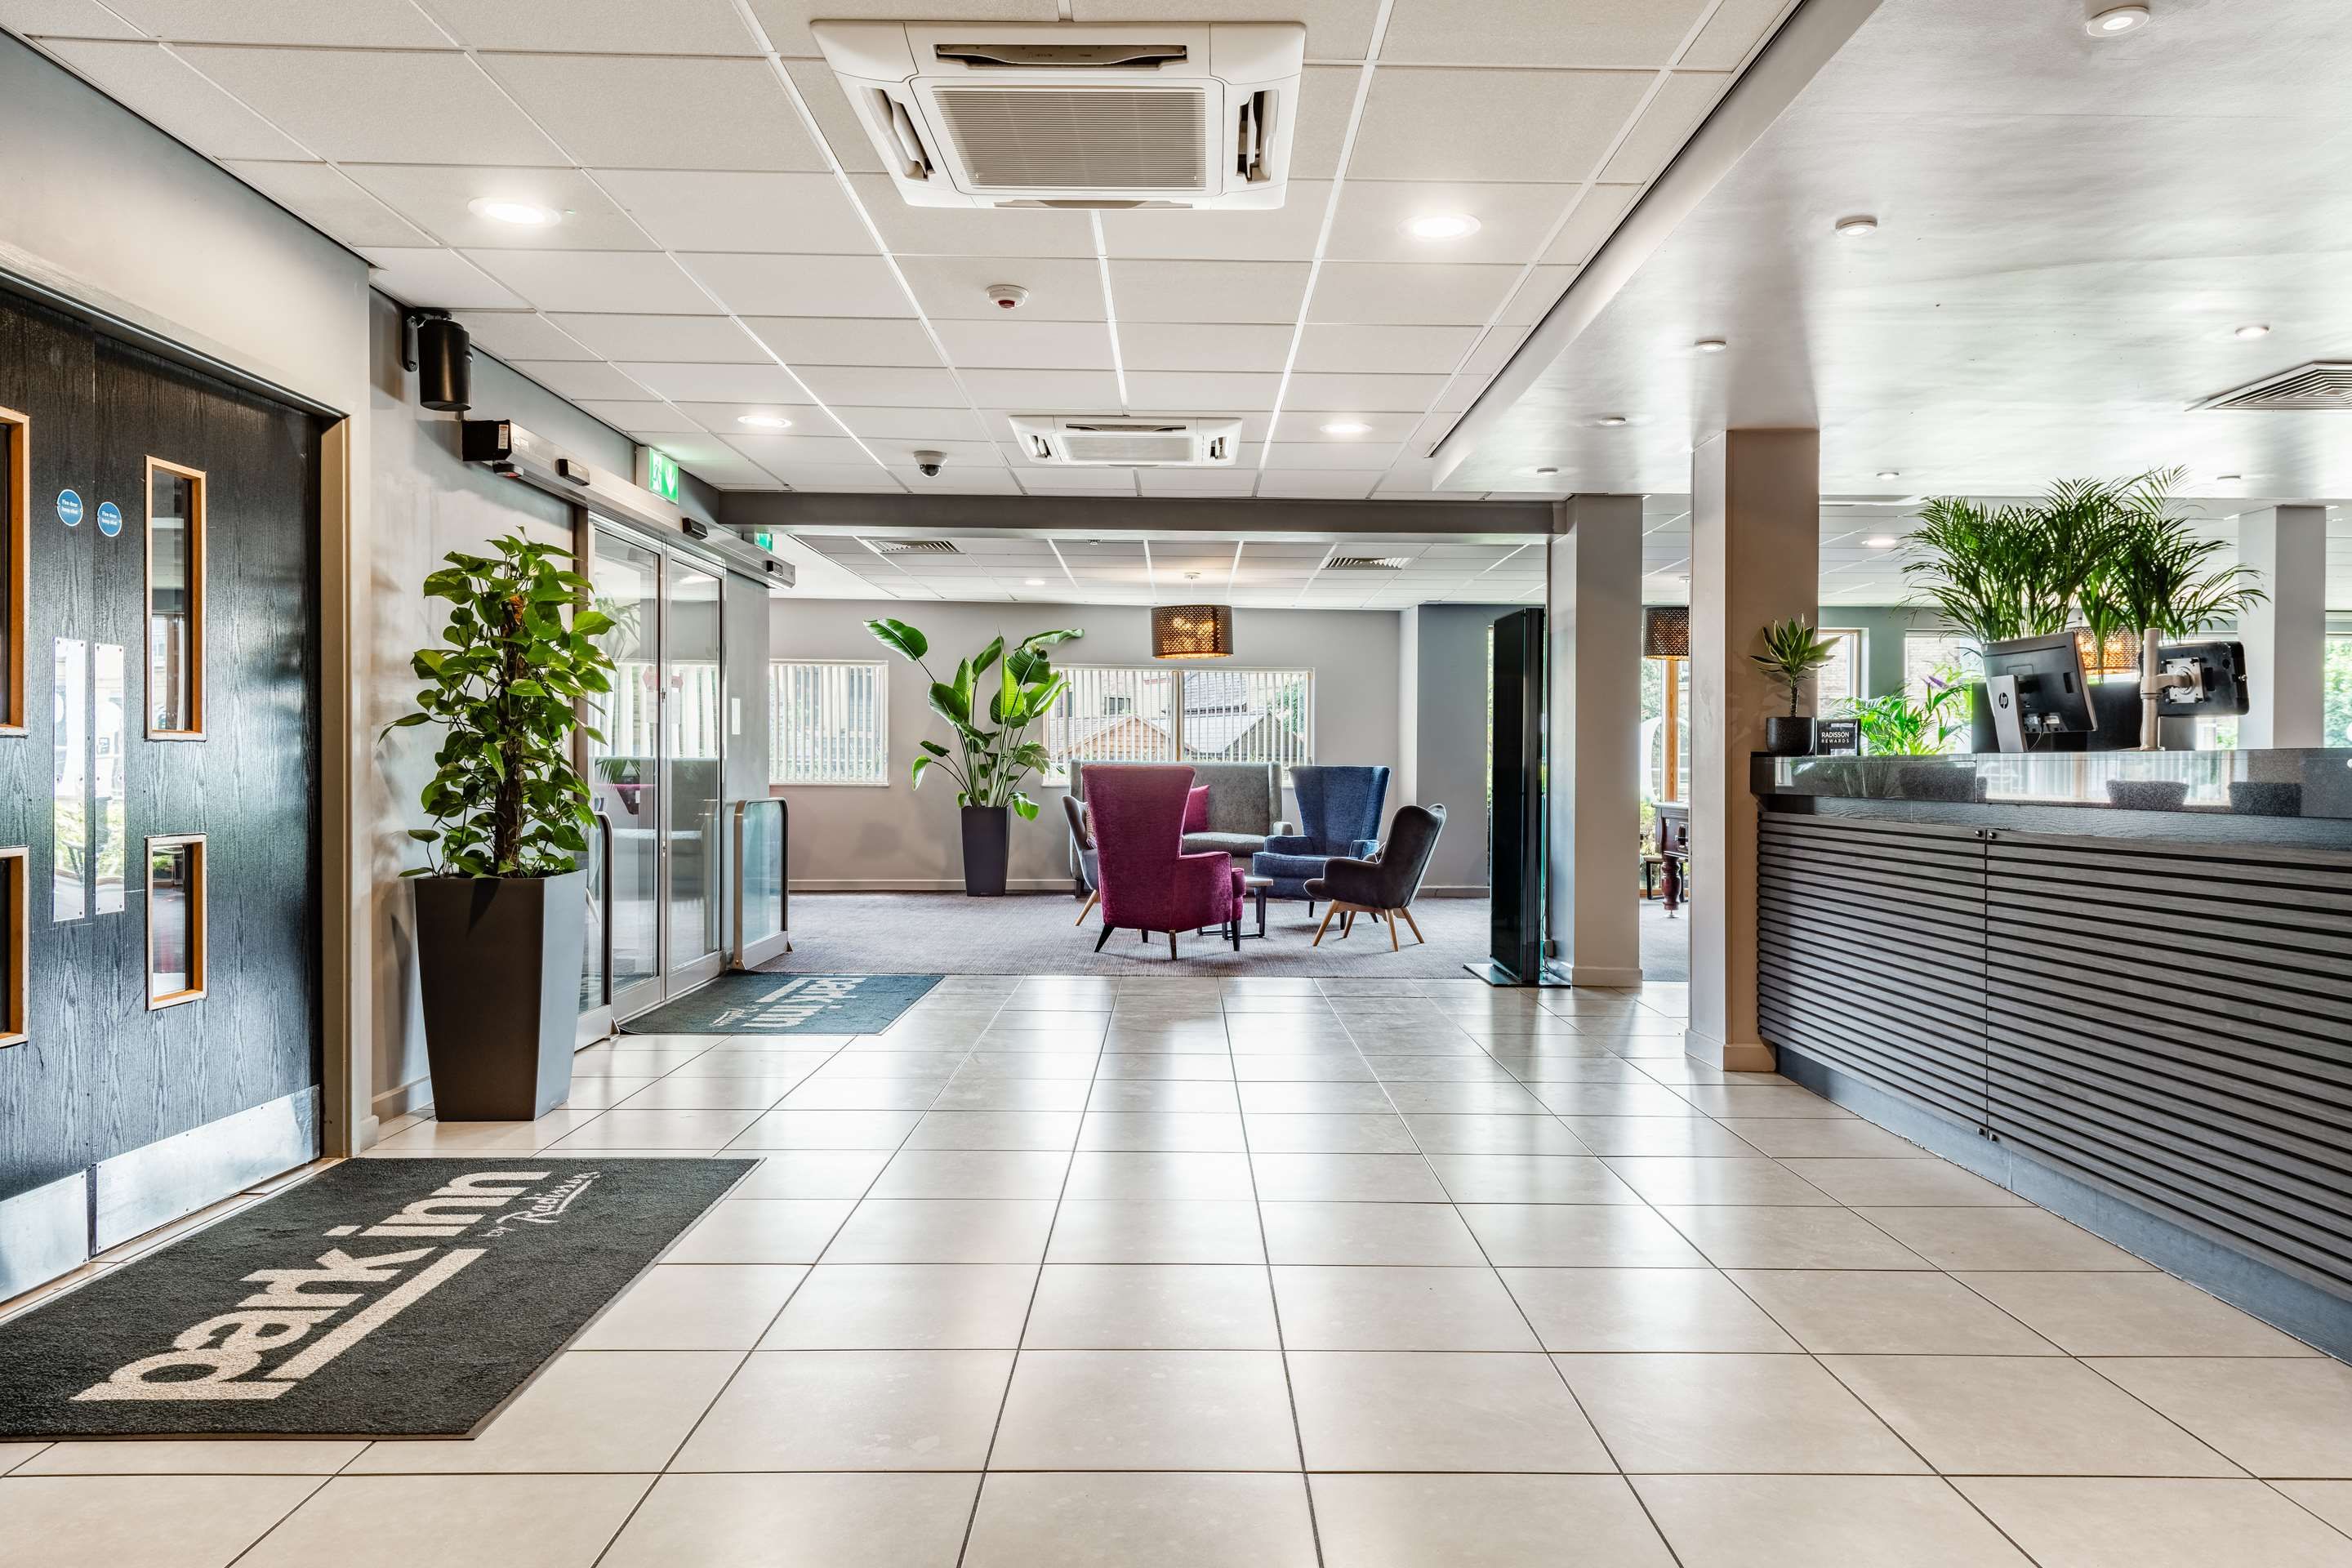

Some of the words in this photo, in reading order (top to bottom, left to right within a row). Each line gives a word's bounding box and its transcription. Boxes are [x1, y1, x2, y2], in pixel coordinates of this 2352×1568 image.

[2000, 693, 2008, 709] hp
[496, 1171, 600, 1224] Radisson
[478, 1227, 515, 1237] by
[70, 1247, 438, 1401] park
[323, 1171, 550, 1236] inn
